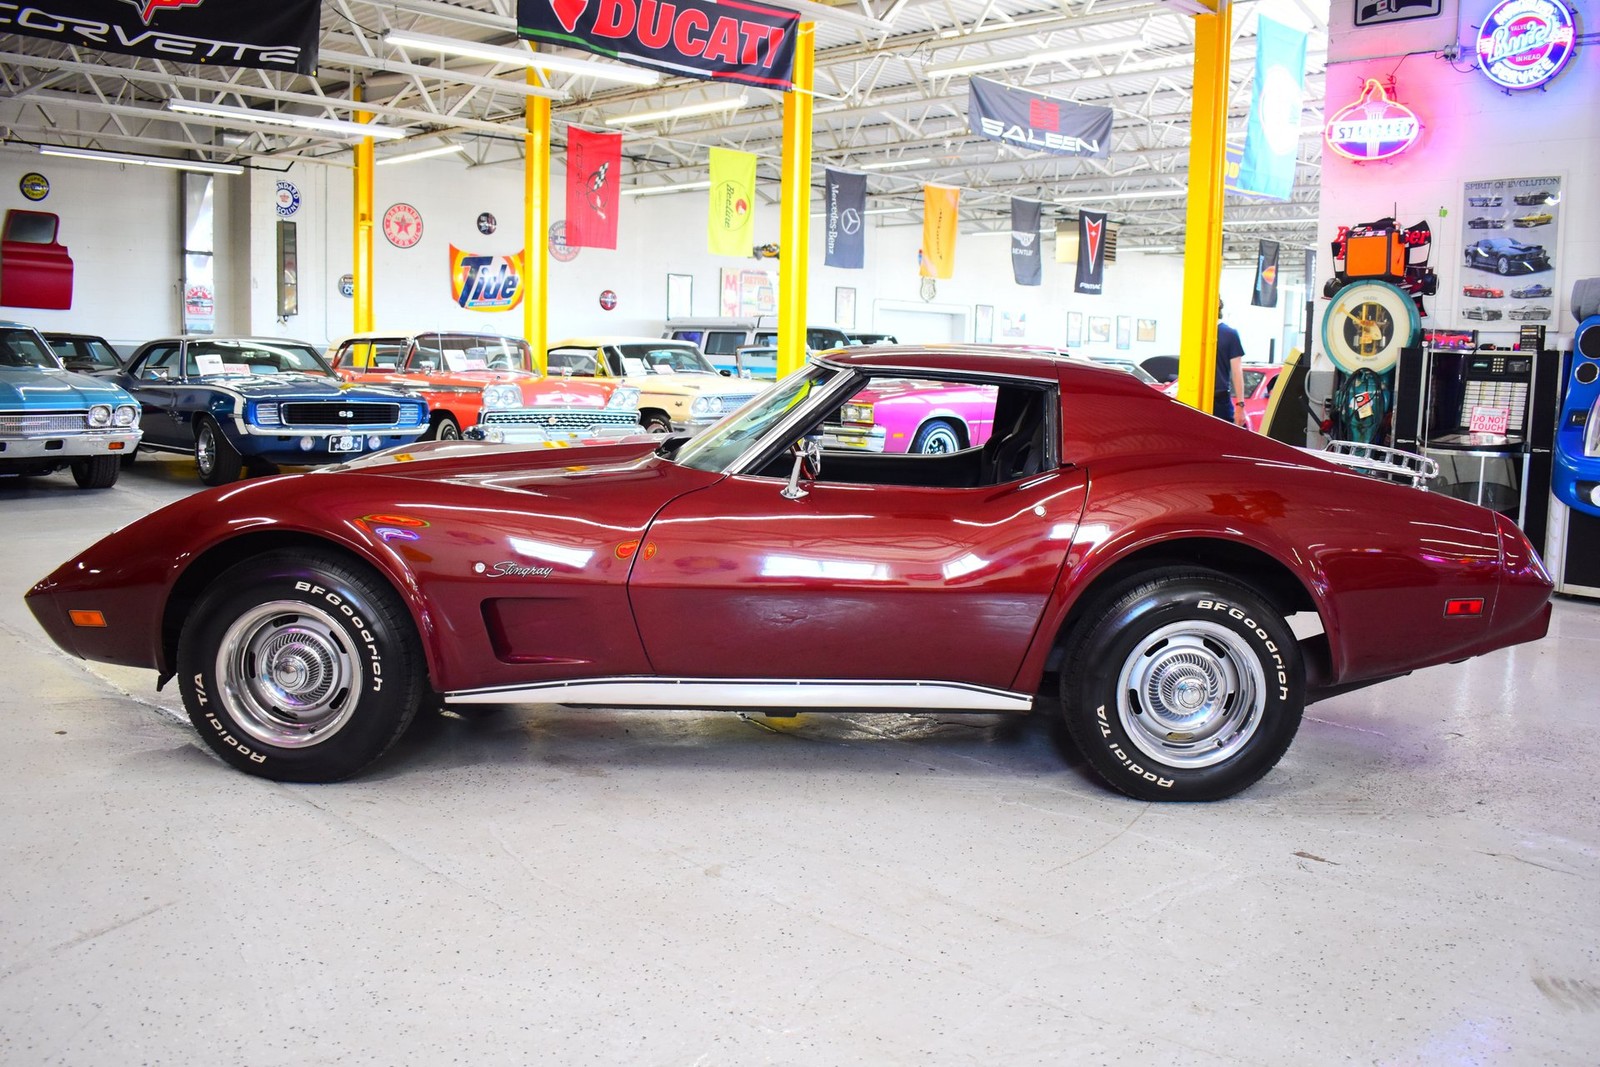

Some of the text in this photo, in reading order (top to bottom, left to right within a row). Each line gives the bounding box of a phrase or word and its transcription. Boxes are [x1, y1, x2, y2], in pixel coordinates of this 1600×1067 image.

[591, 0, 785, 68] DUCATI
[981, 117, 1100, 153] SALEEN
[724, 183, 735, 228] Beeline
[1465, 177, 1560, 190] SPIRIT OF EVOLUTION
[828, 183, 840, 254] Mercedes-Benz
[459, 256, 519, 308] Tide
[1473, 423, 1503, 431] TOUCH
[1488, 416, 1505, 424] NOT
[486, 561, 553, 578] Stingray
[295, 581, 383, 692] BFGoodrich
[1197, 600, 1288, 700] BFGoodrich
[194, 673, 267, 763] Radial T/A
[1096, 705, 1175, 788] Radial T/A
